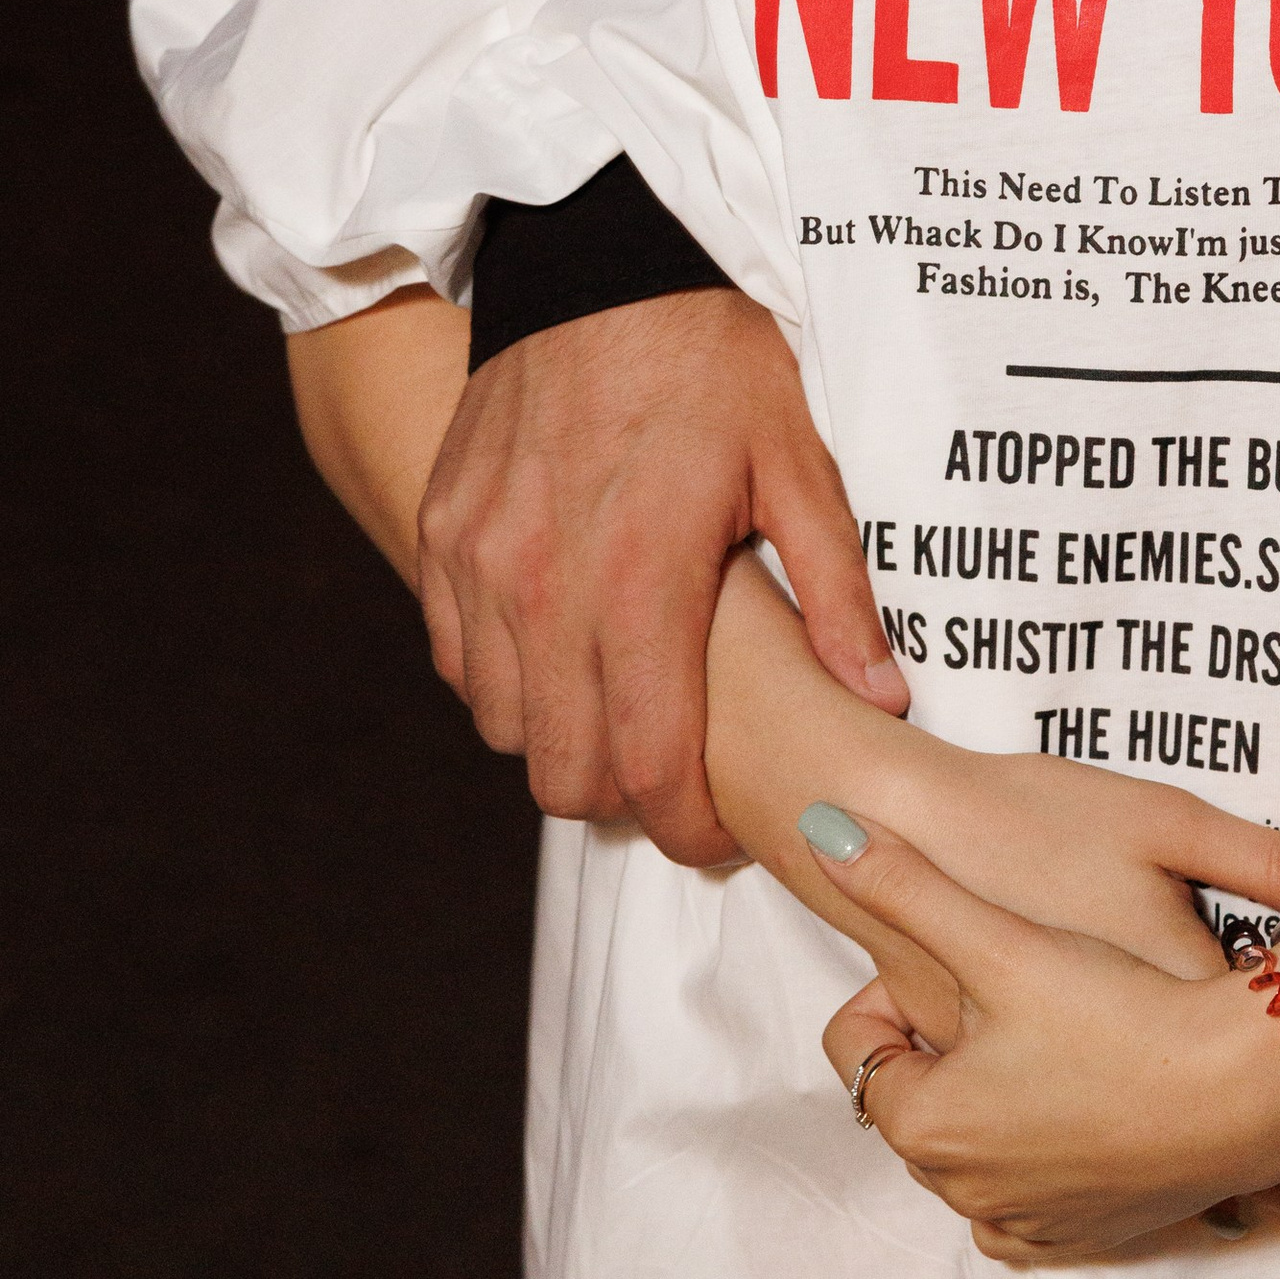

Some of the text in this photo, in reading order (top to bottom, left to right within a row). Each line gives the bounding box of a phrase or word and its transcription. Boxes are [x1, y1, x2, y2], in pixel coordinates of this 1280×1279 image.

[914, 166, 988, 199] This
[998, 171, 1082, 204] Need
[1093, 175, 1138, 206] To
[1148, 176, 1252, 207] Listen
[799, 215, 856, 246] But
[868, 214, 983, 249] Whack
[993, 220, 1043, 252] Do
[1053, 223, 1067, 254] I
[916, 261, 1053, 300] Fashion
[1063, 268, 1100, 308] is,
[1124, 271, 1191, 305] The
[944, 429, 1136, 490] ATOPPED
[1151, 435, 1232, 489] THE
[913, 523, 1040, 583] KIUHE
[943, 616, 1105, 675] SHISTIT
[1116, 618, 1194, 675] THE
[1034, 706, 1261, 775] THE HUEEN
